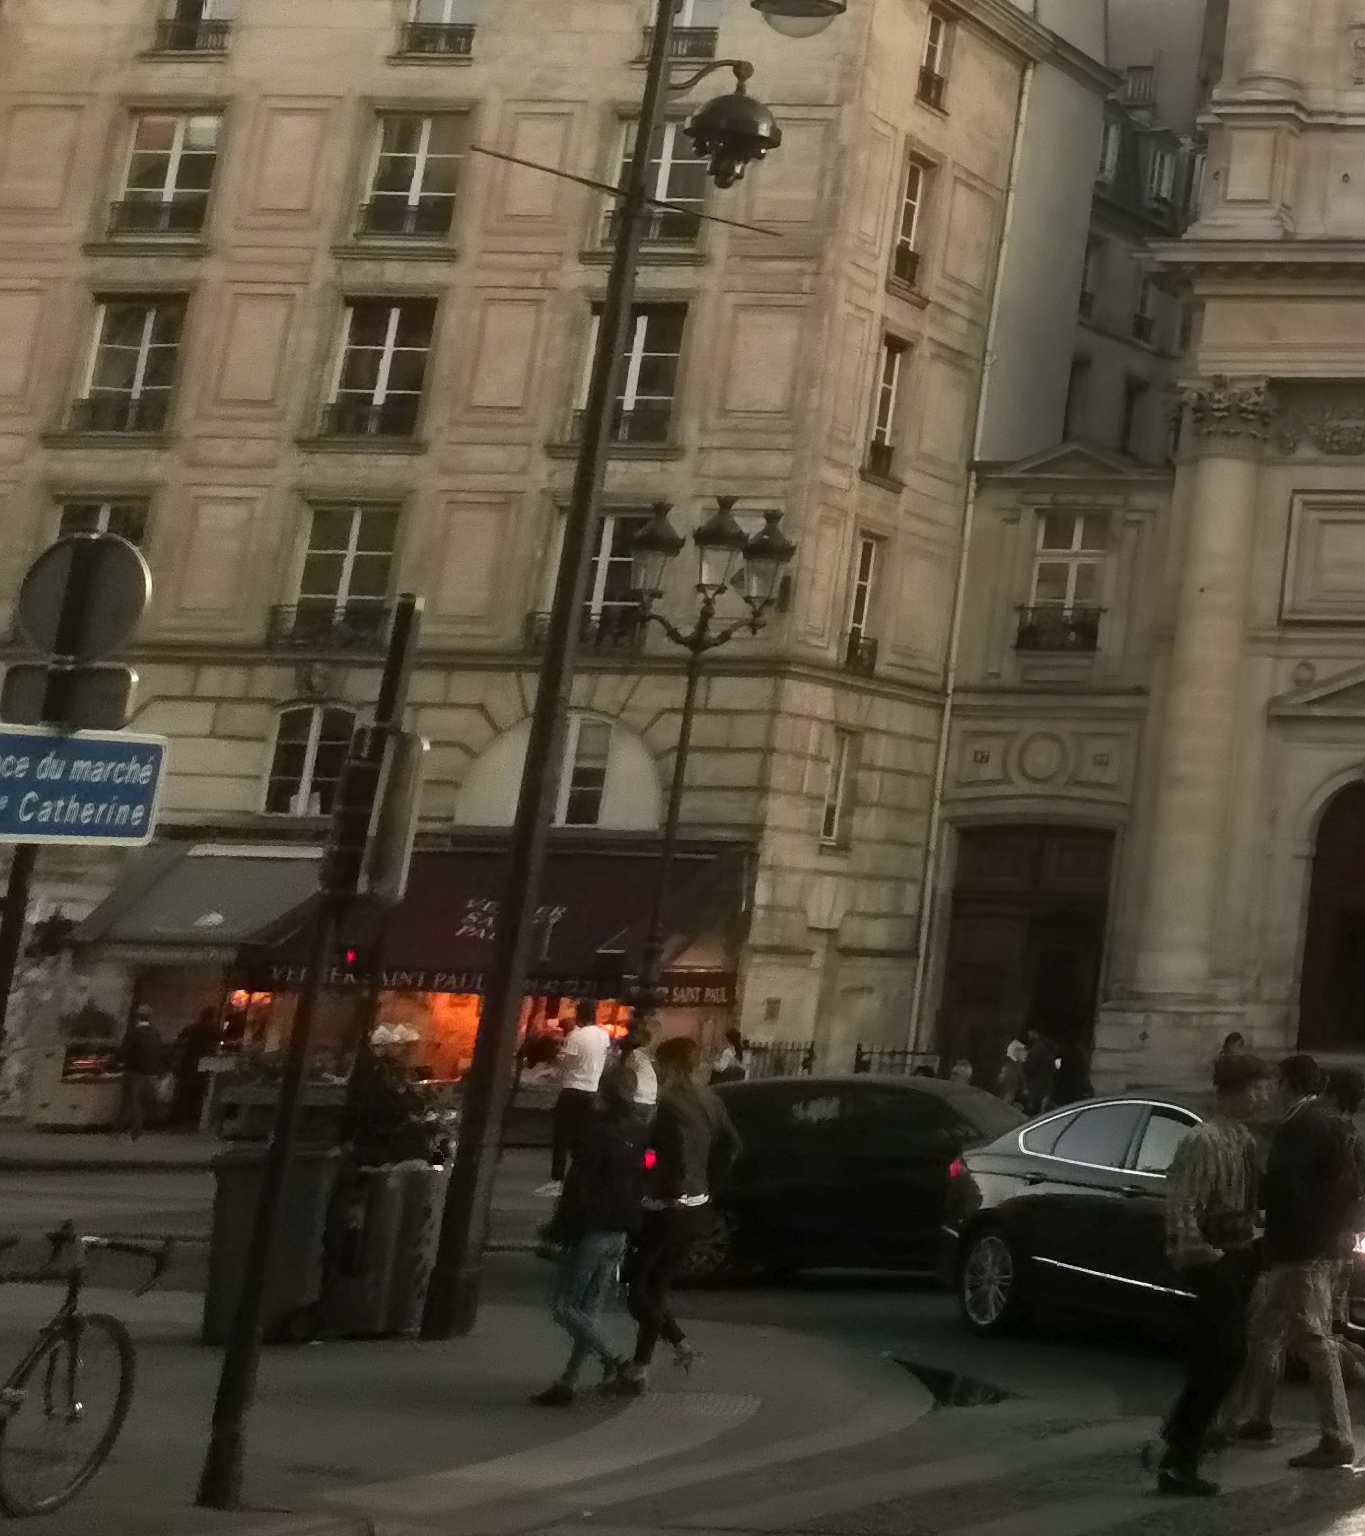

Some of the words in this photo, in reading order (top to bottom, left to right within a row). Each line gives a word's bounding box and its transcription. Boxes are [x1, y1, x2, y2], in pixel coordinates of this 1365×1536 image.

[0, 754, 30, 779] ce
[36, 750, 66, 781] du
[69, 755, 155, 785] marché
[18, 791, 145, 826] Catherine
